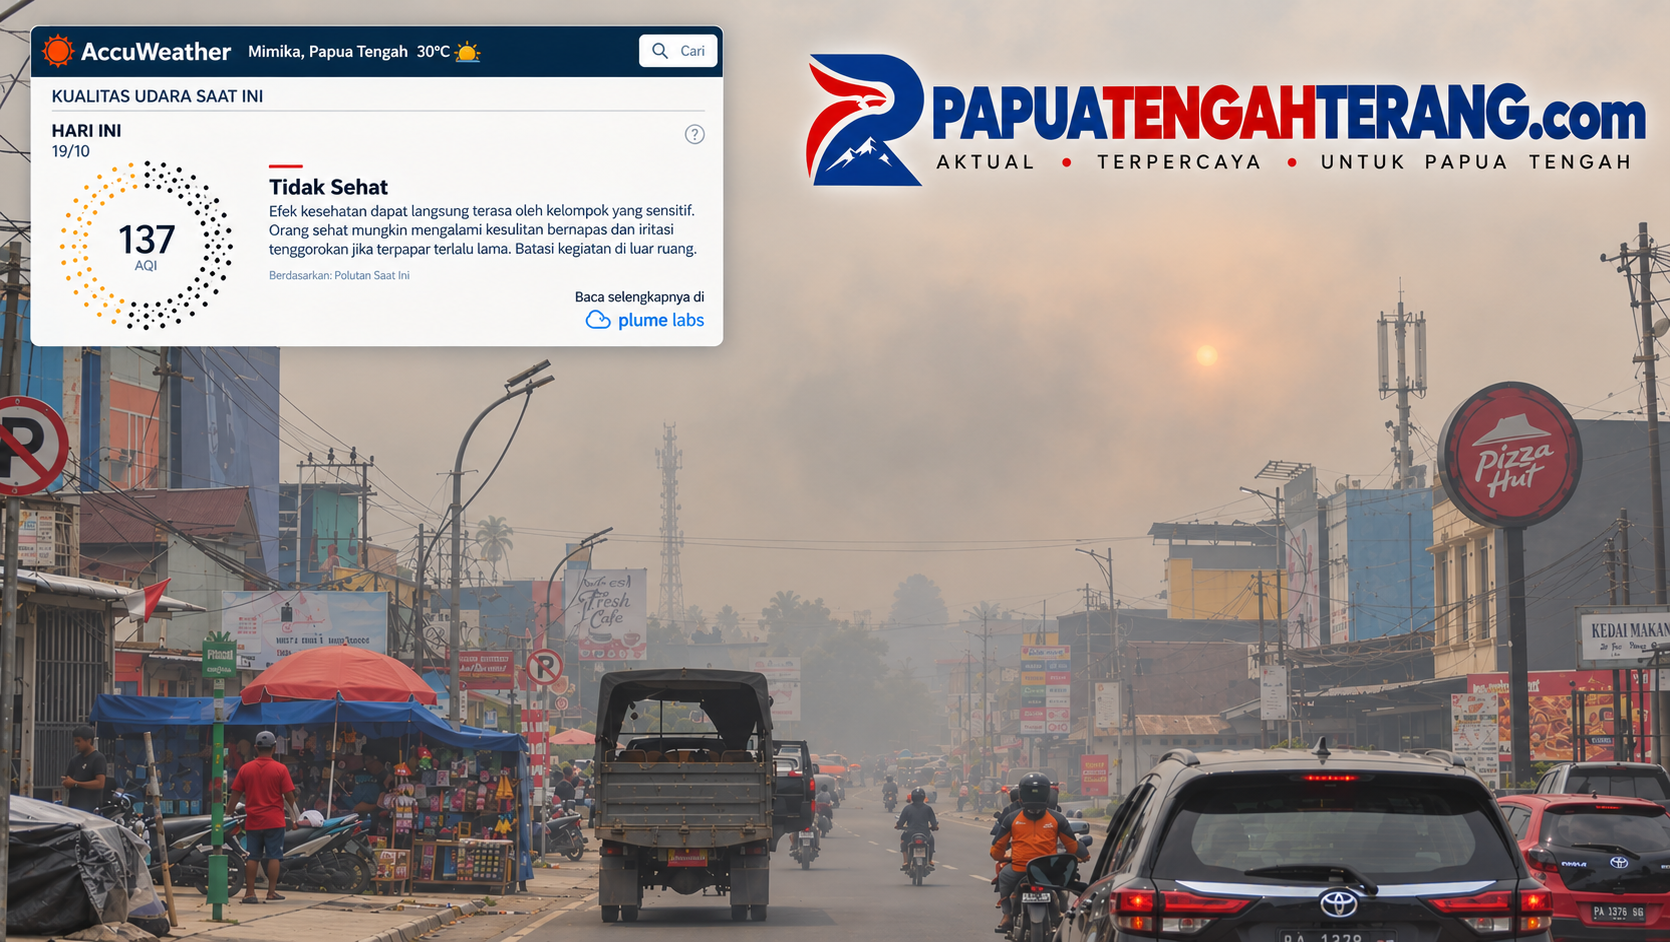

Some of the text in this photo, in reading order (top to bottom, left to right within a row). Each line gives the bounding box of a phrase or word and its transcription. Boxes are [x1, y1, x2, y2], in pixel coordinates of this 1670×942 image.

[1475, 444, 1555, 483] Pizza
[1487, 462, 1545, 499] Hut
[1592, 623, 1628, 639] KEDAI
[537, 655, 555, 679] P
